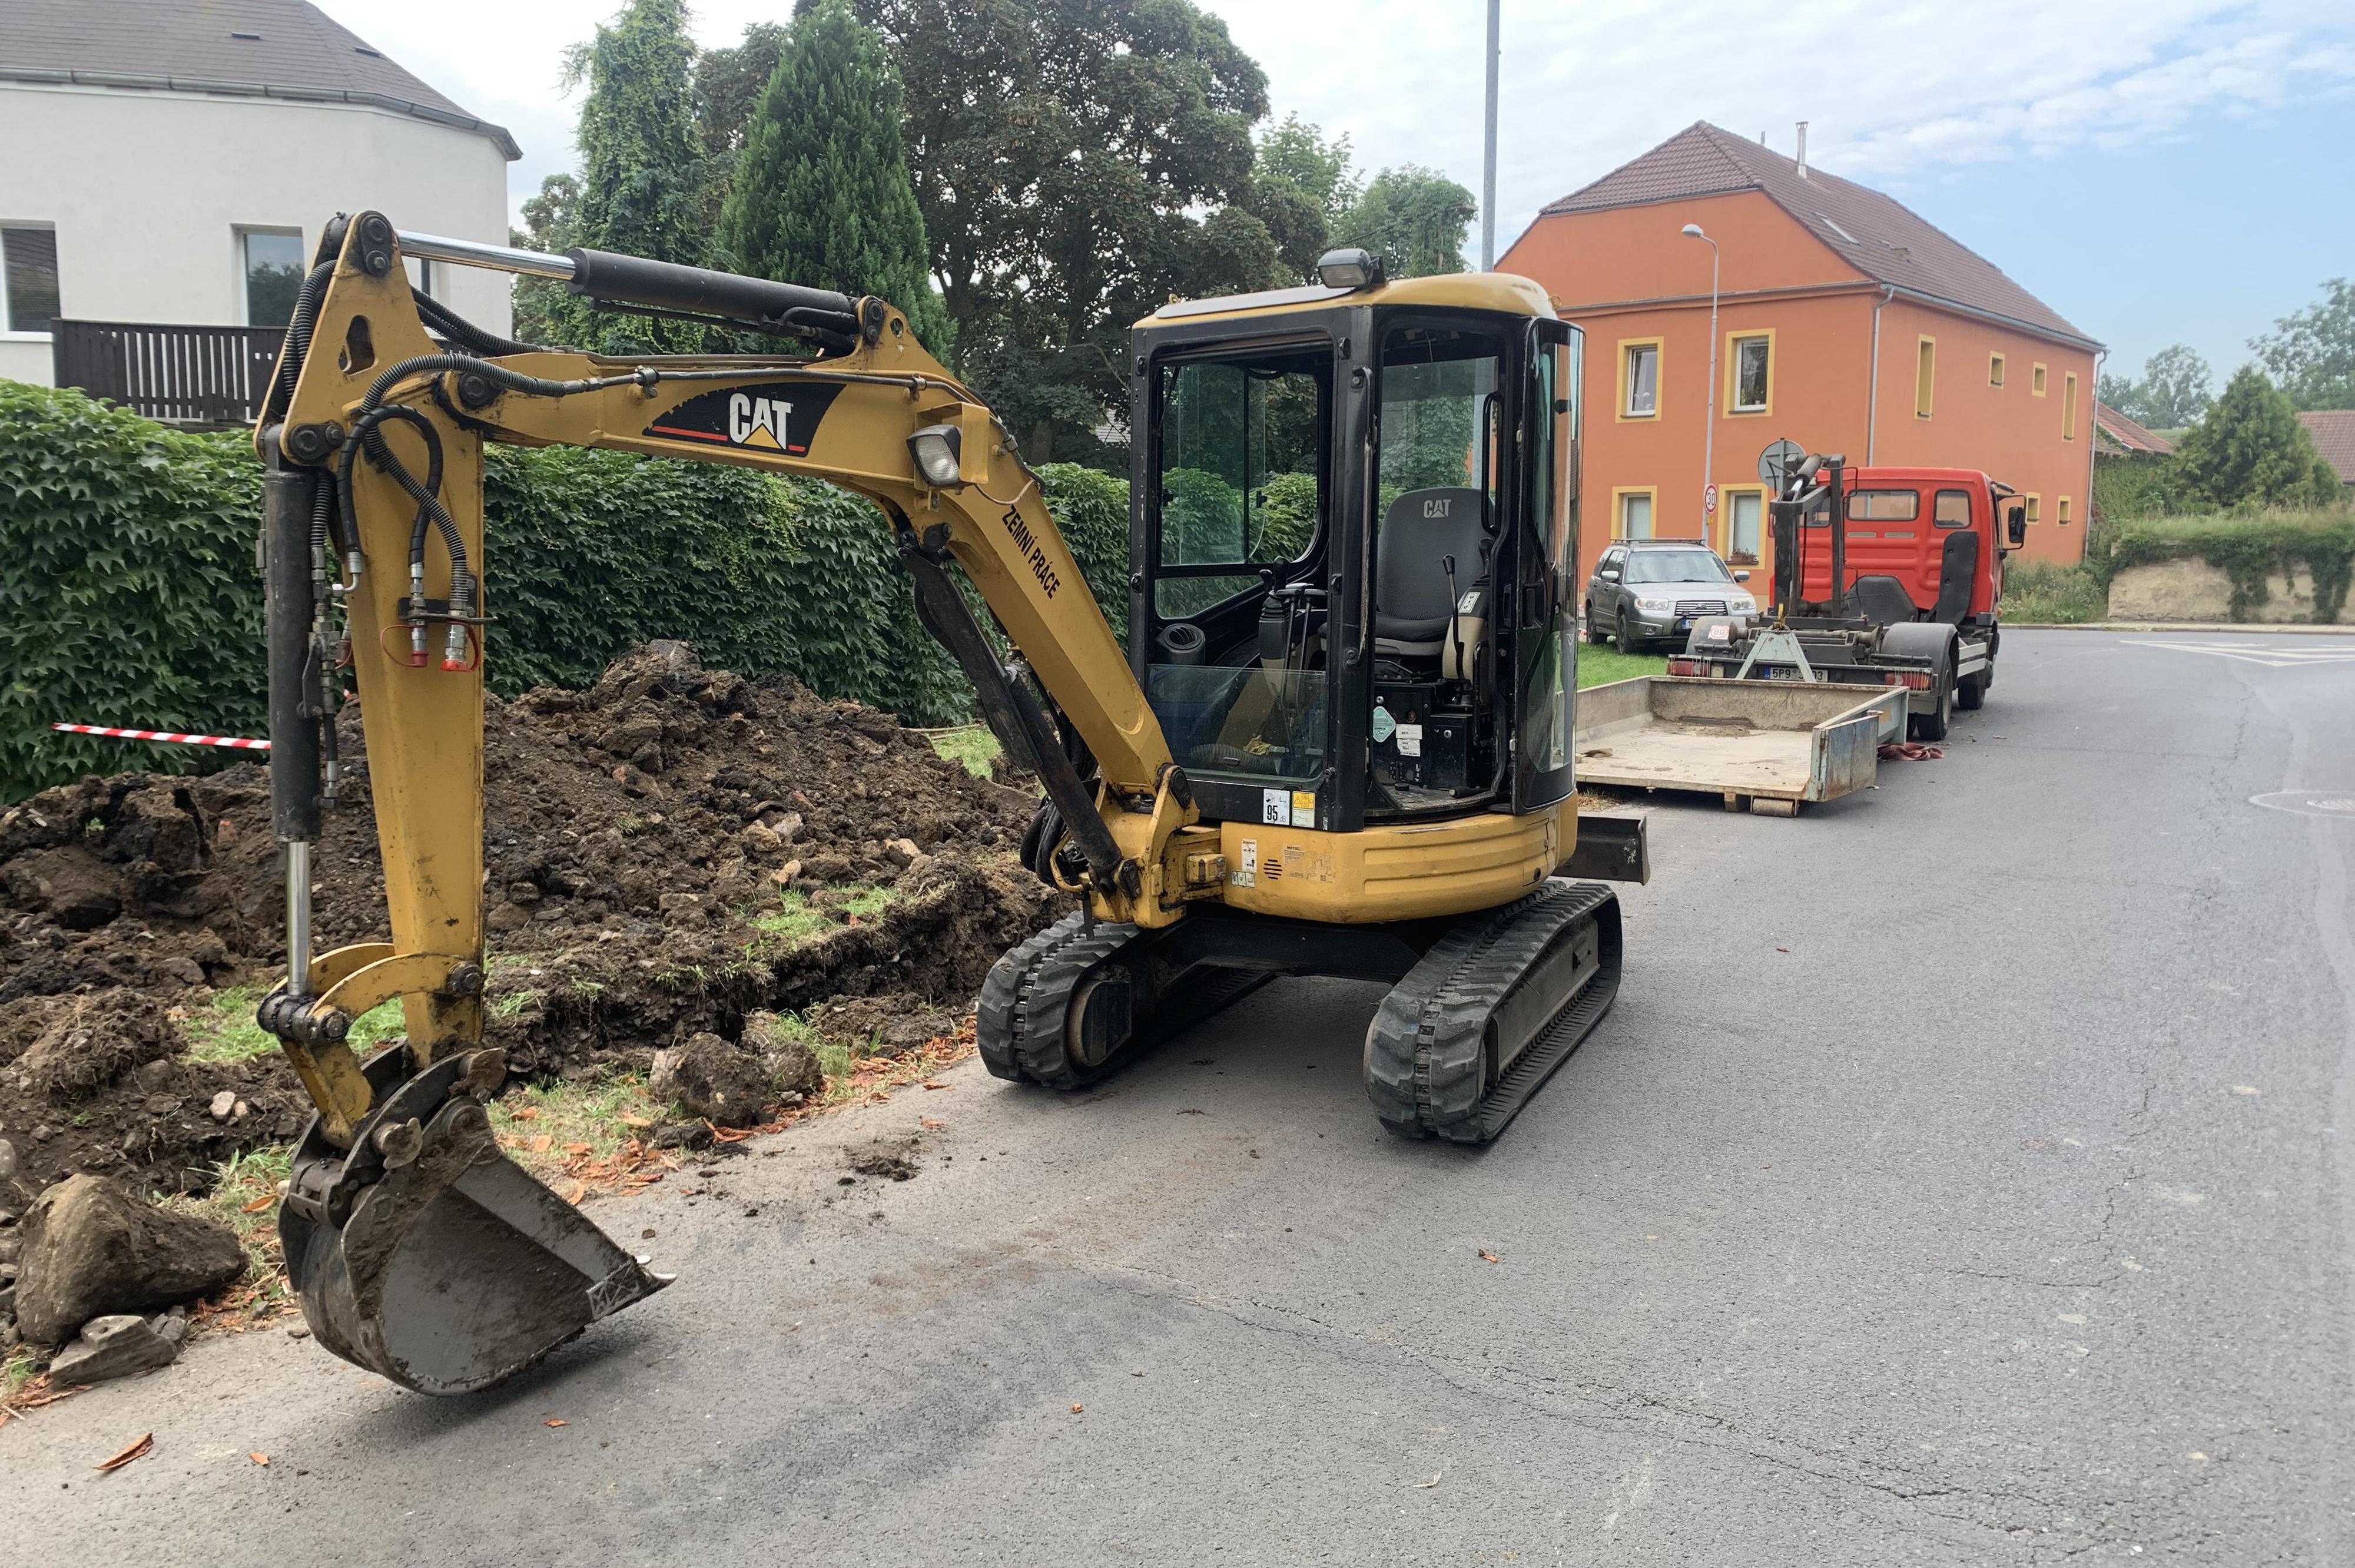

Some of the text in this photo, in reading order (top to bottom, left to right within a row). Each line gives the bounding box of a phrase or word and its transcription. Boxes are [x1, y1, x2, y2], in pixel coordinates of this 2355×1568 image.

[729, 393, 791, 449] CAT
[1707, 493, 1715, 505] 30
[1424, 499, 1452, 519] CAT
[1002, 505, 1060, 599] ZEMNÍ PRÁCE
[1772, 668, 1791, 679] 5P9
[1267, 804, 1278, 821] 95
